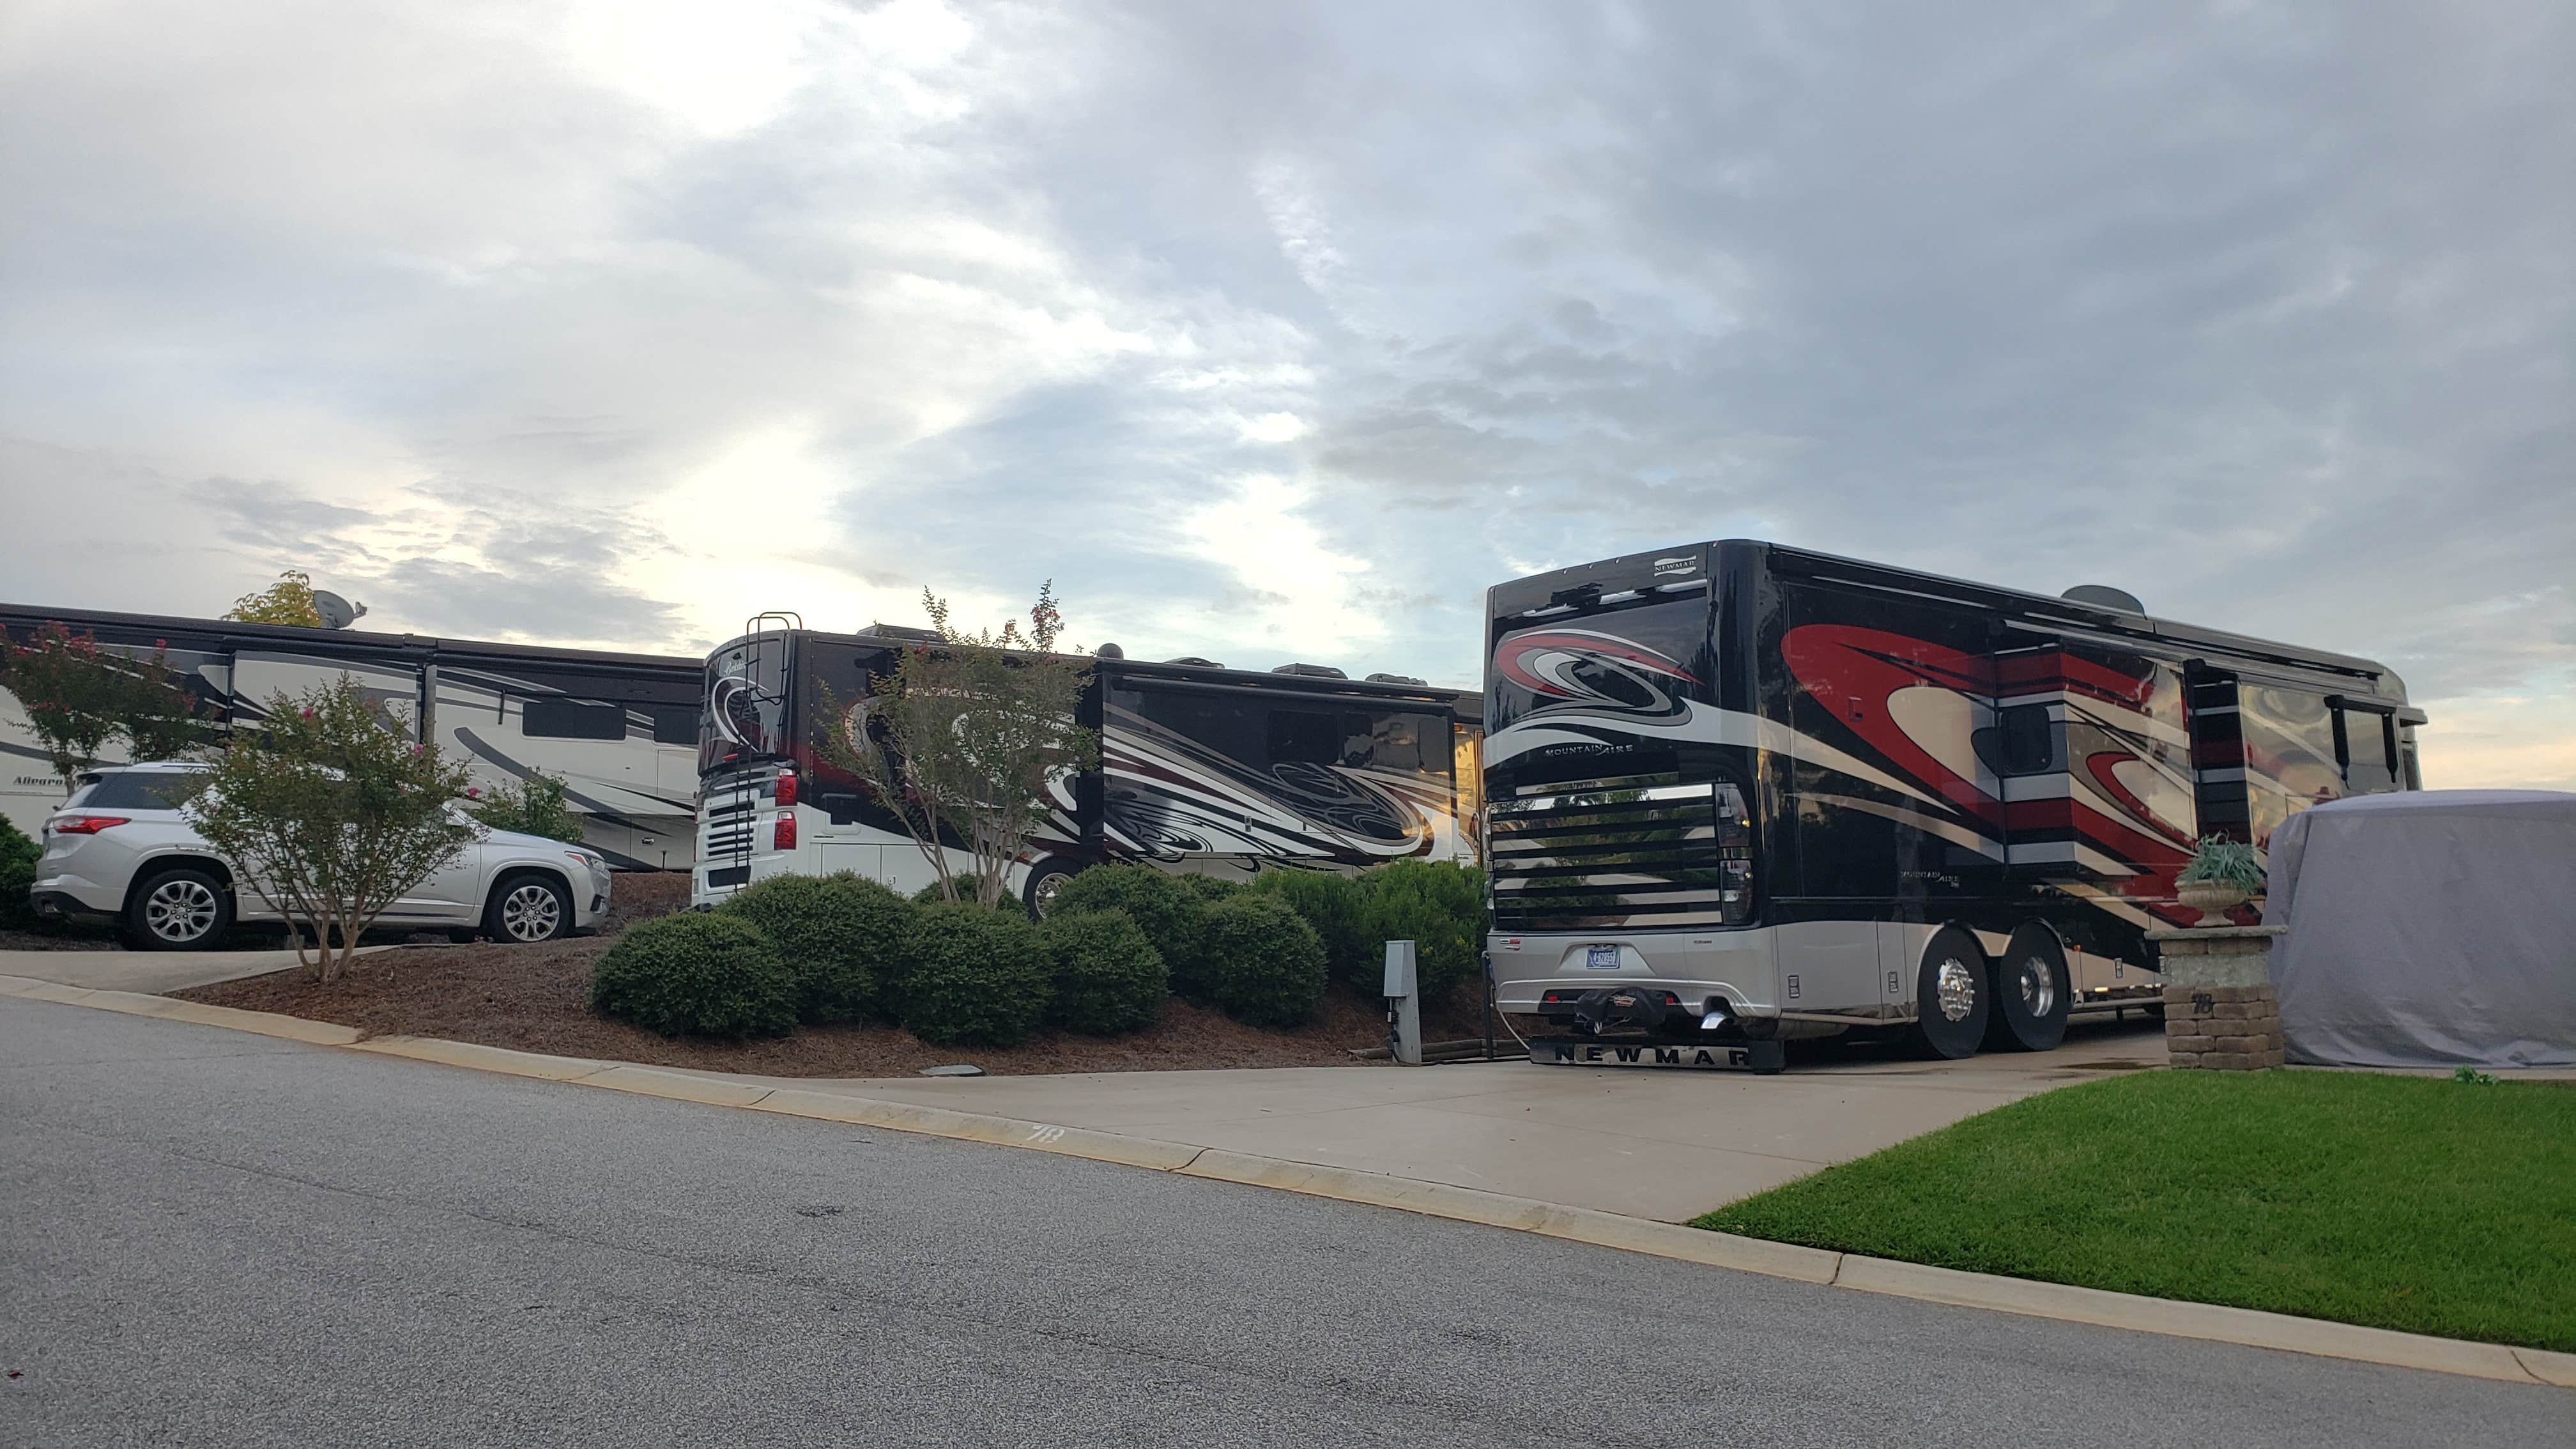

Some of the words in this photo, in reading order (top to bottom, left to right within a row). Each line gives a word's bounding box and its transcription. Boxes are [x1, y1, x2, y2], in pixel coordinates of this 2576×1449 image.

[1655, 560, 1694, 571] NEWMAR
[2192, 993, 2212, 1014] 78
[1555, 1046, 1749, 1065] NEWMAR
